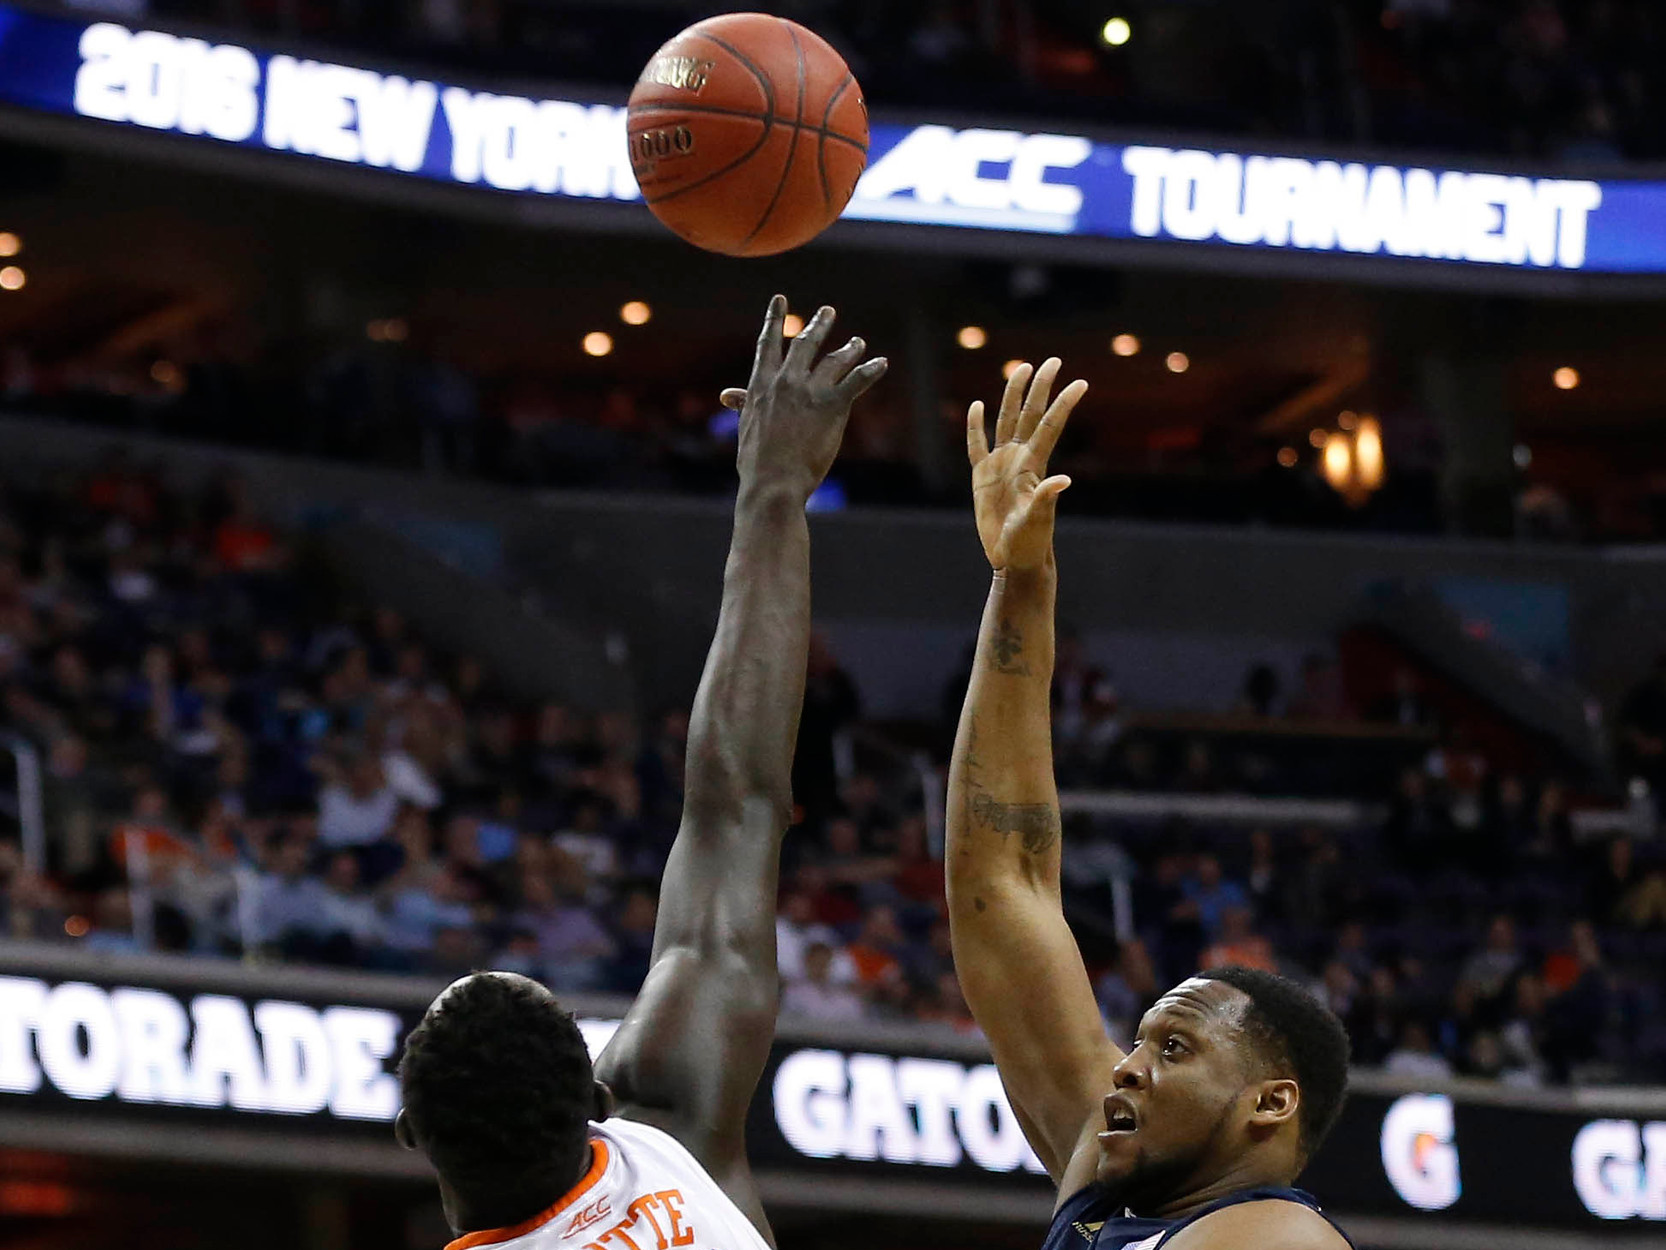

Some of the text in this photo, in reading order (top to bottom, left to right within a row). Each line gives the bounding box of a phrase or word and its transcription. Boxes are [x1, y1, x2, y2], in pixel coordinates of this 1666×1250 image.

[74, 22, 1601, 268] 2016 NEW YORK ACC TOURNAMENT
[773, 1048, 1048, 1175] GATO
[1380, 1093, 1462, 1212] G
[563, 1195, 612, 1239] ACC
